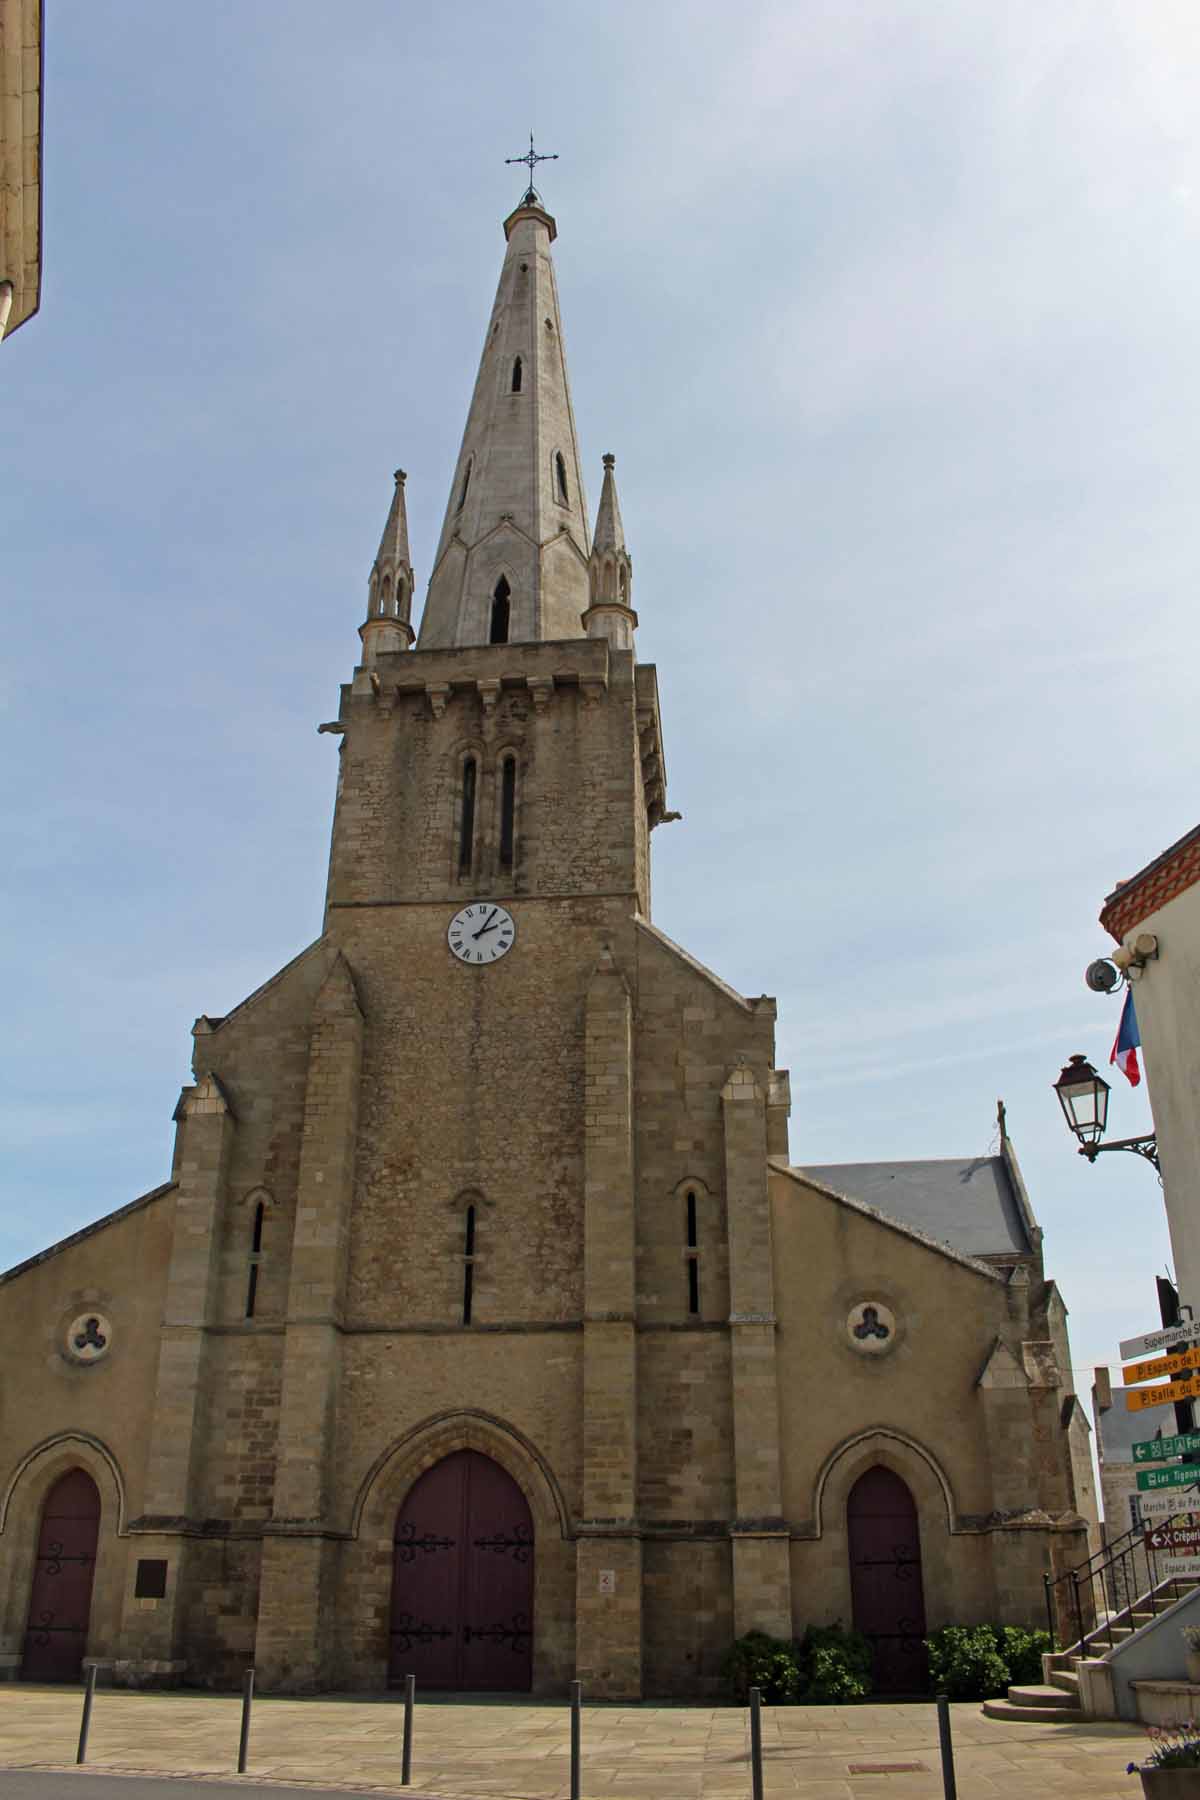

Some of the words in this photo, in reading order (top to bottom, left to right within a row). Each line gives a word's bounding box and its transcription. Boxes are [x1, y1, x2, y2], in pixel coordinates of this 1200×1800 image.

[1143, 1327, 1192, 1350] Supermarché
[1147, 1358, 1178, 1375] Espace
[1180, 1353, 1192, 1367] de
[1151, 1386, 1176, 1402] Salle
